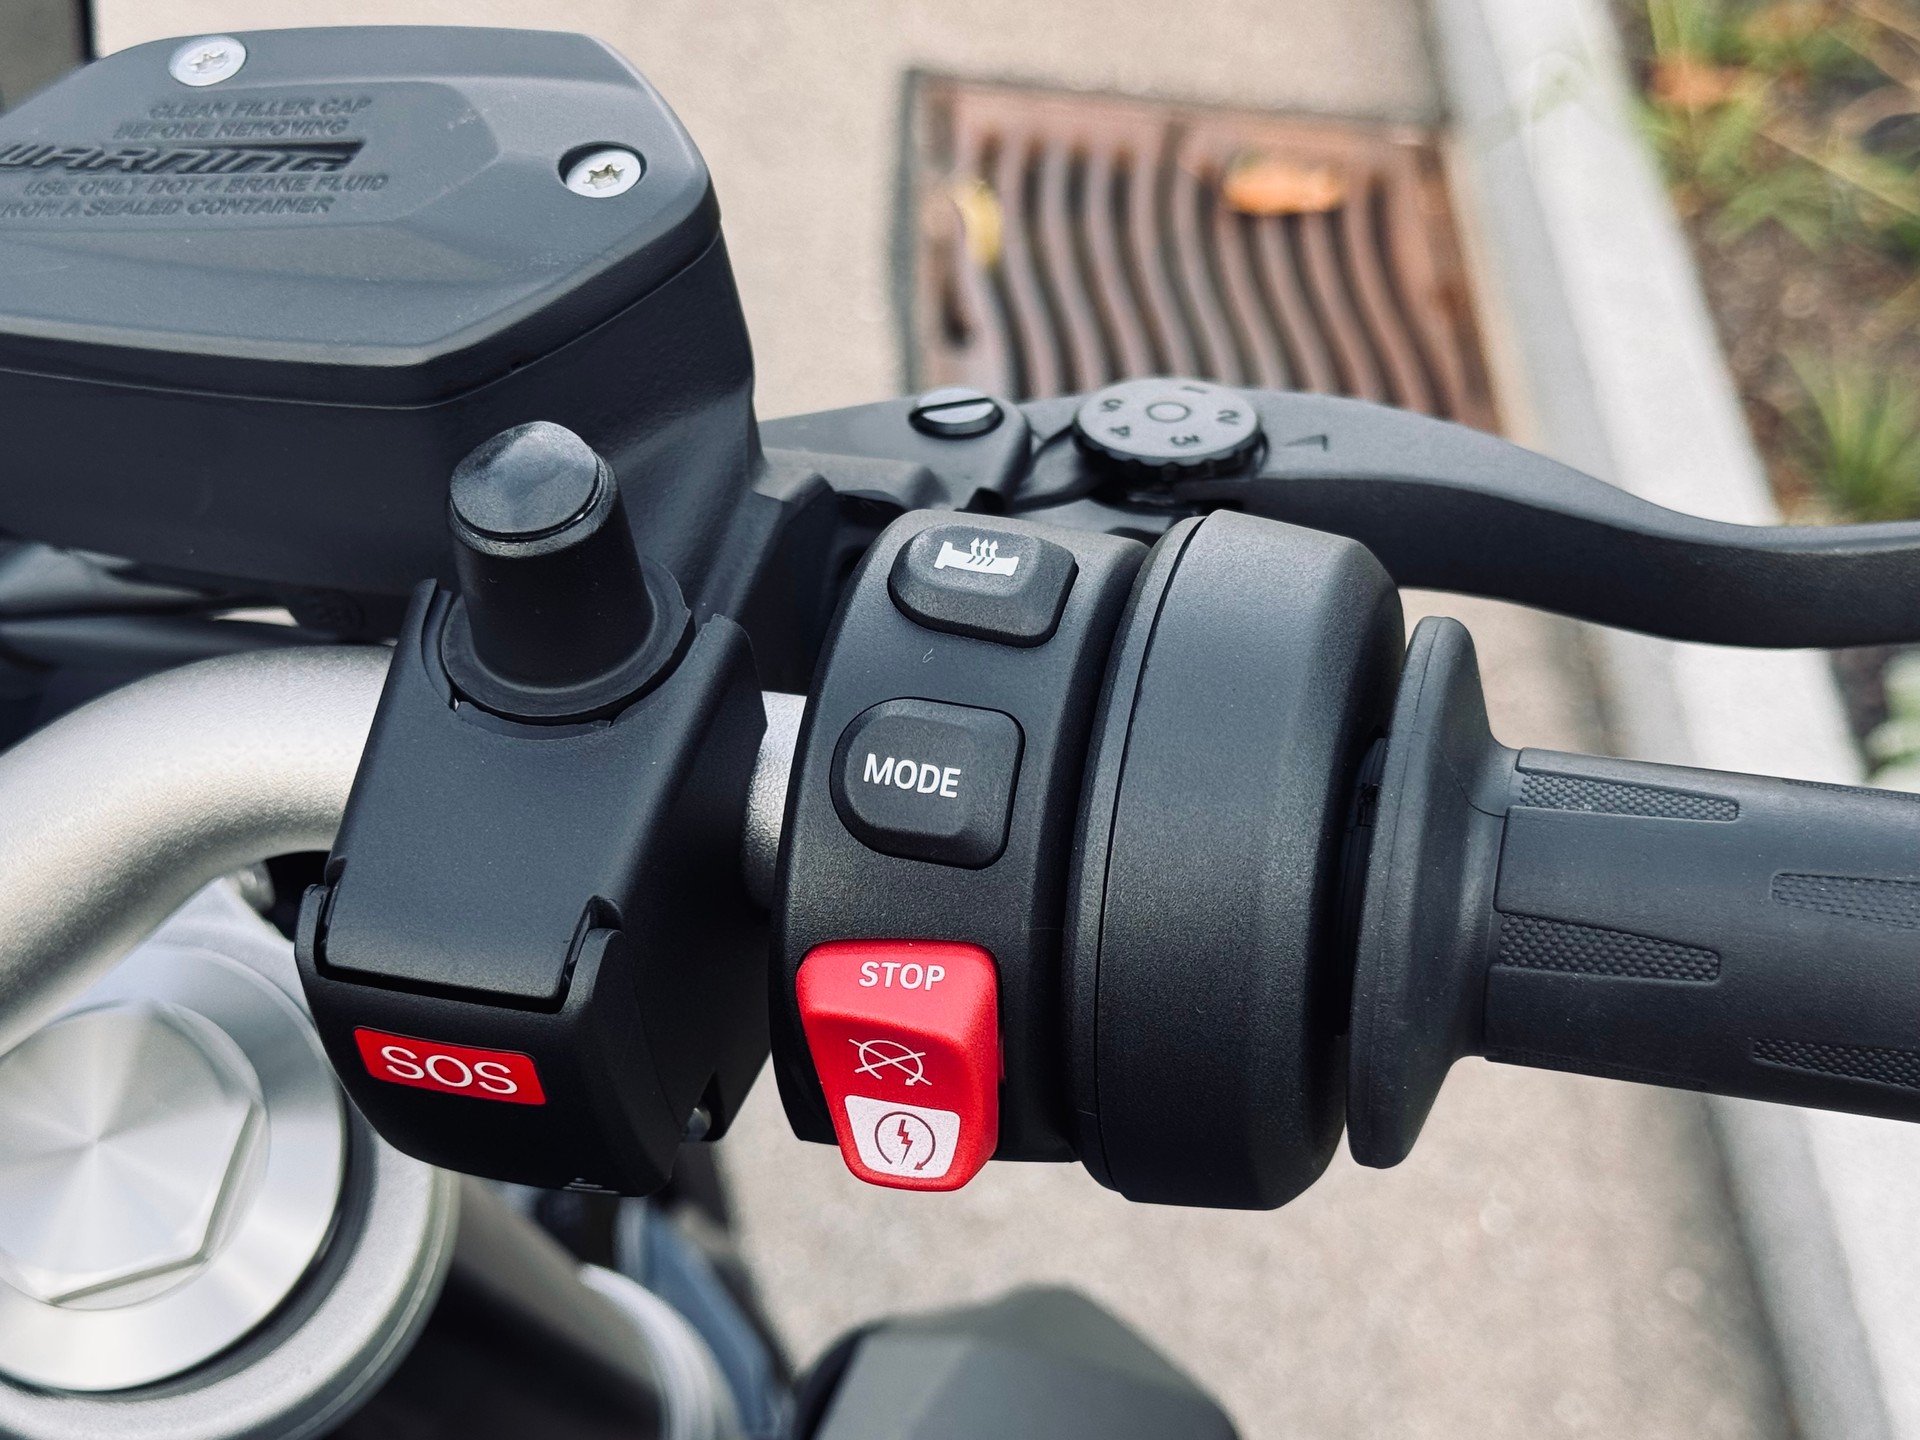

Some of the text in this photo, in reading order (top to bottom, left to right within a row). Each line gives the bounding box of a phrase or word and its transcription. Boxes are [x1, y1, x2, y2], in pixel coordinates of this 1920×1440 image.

[231, 98, 315, 116] FILLER
[318, 95, 373, 114] CAP
[215, 117, 349, 137] REMOVING
[78, 178, 145, 196] ONLY
[147, 177, 204, 195] DOT
[223, 175, 311, 194] BRAKE
[313, 172, 389, 192] FLUID
[0, 200, 58, 217] ROM
[84, 199, 184, 216] SEALED
[187, 196, 336, 215] CONTAINER
[1216, 408, 1240, 426] 2
[1169, 434, 1201, 447] 3
[863, 753, 961, 798] MODE
[858, 961, 946, 991] STOP
[381, 1045, 518, 1094] SOS
